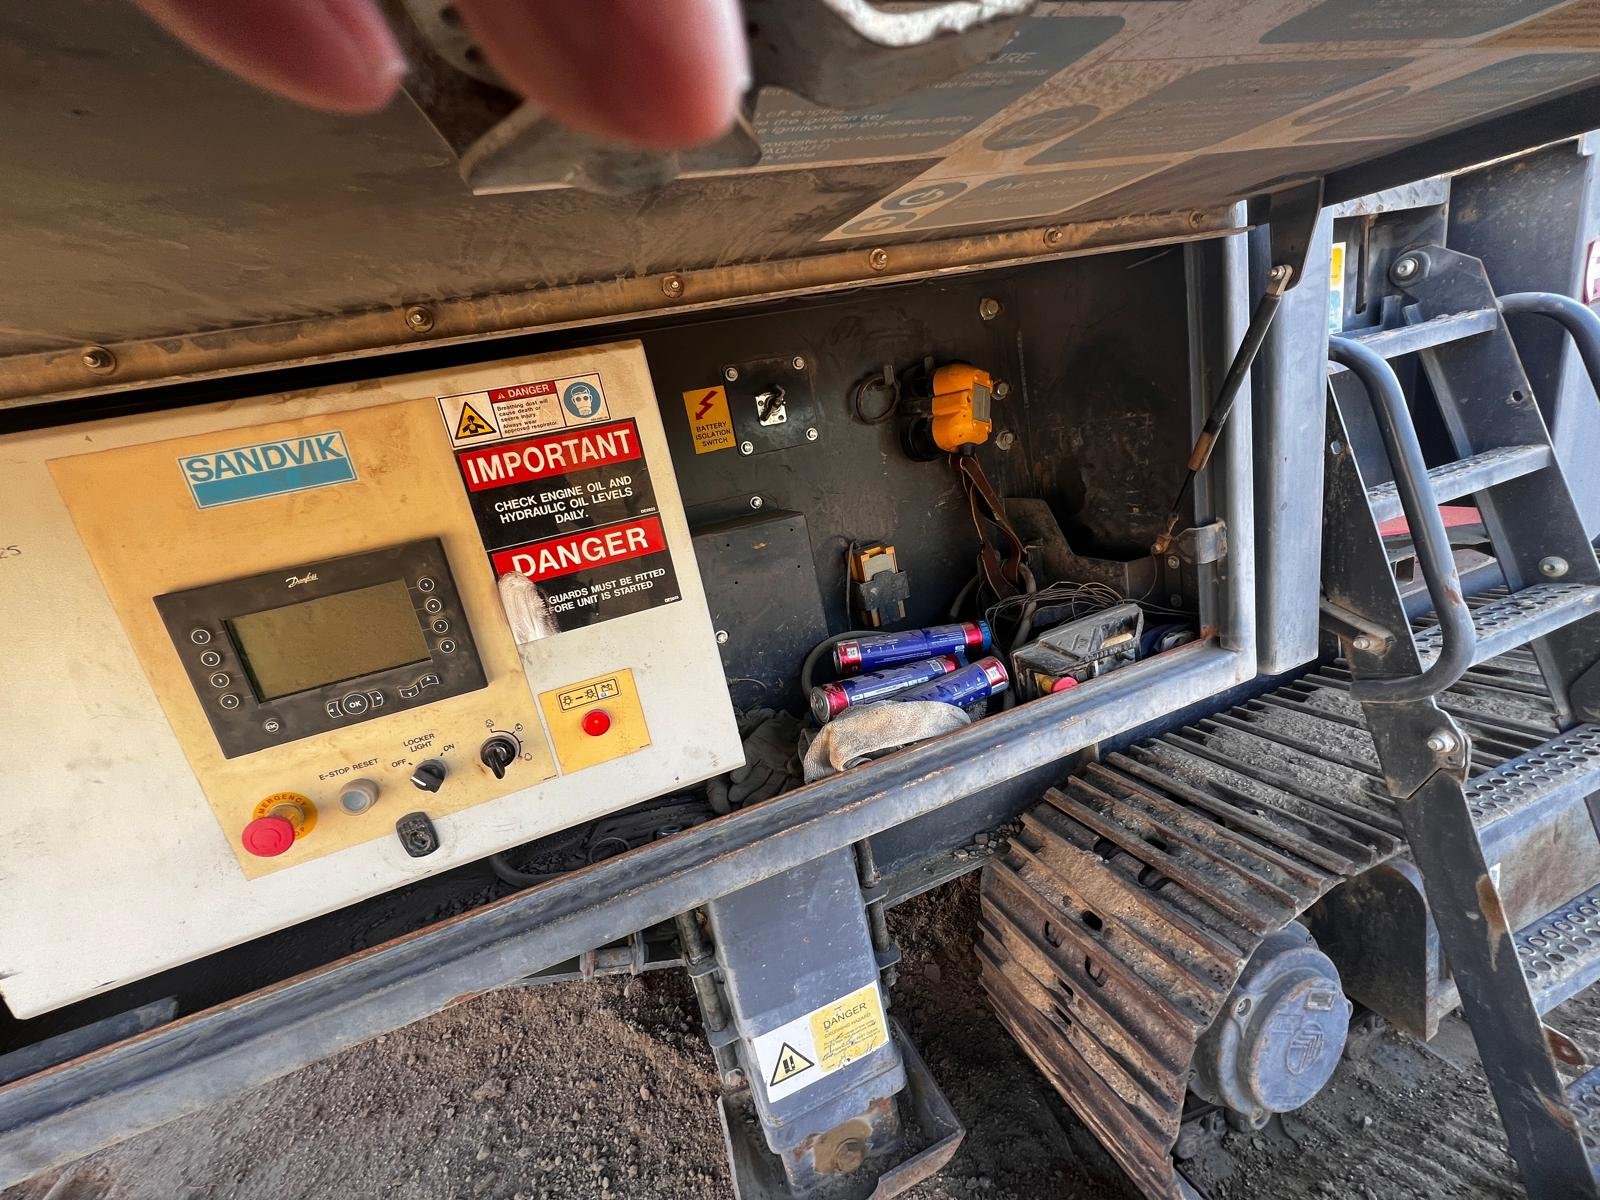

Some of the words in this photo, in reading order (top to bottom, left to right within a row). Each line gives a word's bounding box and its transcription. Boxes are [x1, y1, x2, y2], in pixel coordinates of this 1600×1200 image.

[508, 384, 550, 398] DANGER
[497, 402, 524, 412] Breathing
[503, 421, 523, 430] Always
[504, 425, 531, 435] approved
[696, 421, 727, 433] BATTERY
[695, 428, 731, 441] ISOLATION
[702, 437, 729, 448] SWITCH
[185, 434, 344, 482] SANDVIK
[467, 429, 631, 485] IMPORTANT
[494, 494, 537, 513] CHECK
[540, 485, 584, 504] ENGINE
[587, 481, 606, 494] OIL
[609, 475, 632, 488] AND
[500, 501, 566, 524] HYDRAULIC
[570, 496, 589, 509] OIL
[592, 487, 634, 504] LEVELS
[555, 509, 590, 524] DAILY.
[512, 527, 649, 577] DANGER
[549, 587, 589, 605] GUARDS
[591, 579, 617, 593] MUST
[619, 576, 633, 586] BE
[635, 567, 666, 582] FITTED
[577, 595, 599, 607] UNIT
[601, 591, 611, 601] IS
[614, 580, 654, 598] STARTED
[349, 700, 362, 709] OK
[403, 733, 435, 747] LOCKER
[410, 741, 433, 753] LIGHT
[443, 743, 455, 752] ON
[319, 767, 350, 781] E-STOP
[352, 758, 379, 771] RESET
[391, 758, 407, 768] OFF
[823, 1002, 867, 1030] DANGER
